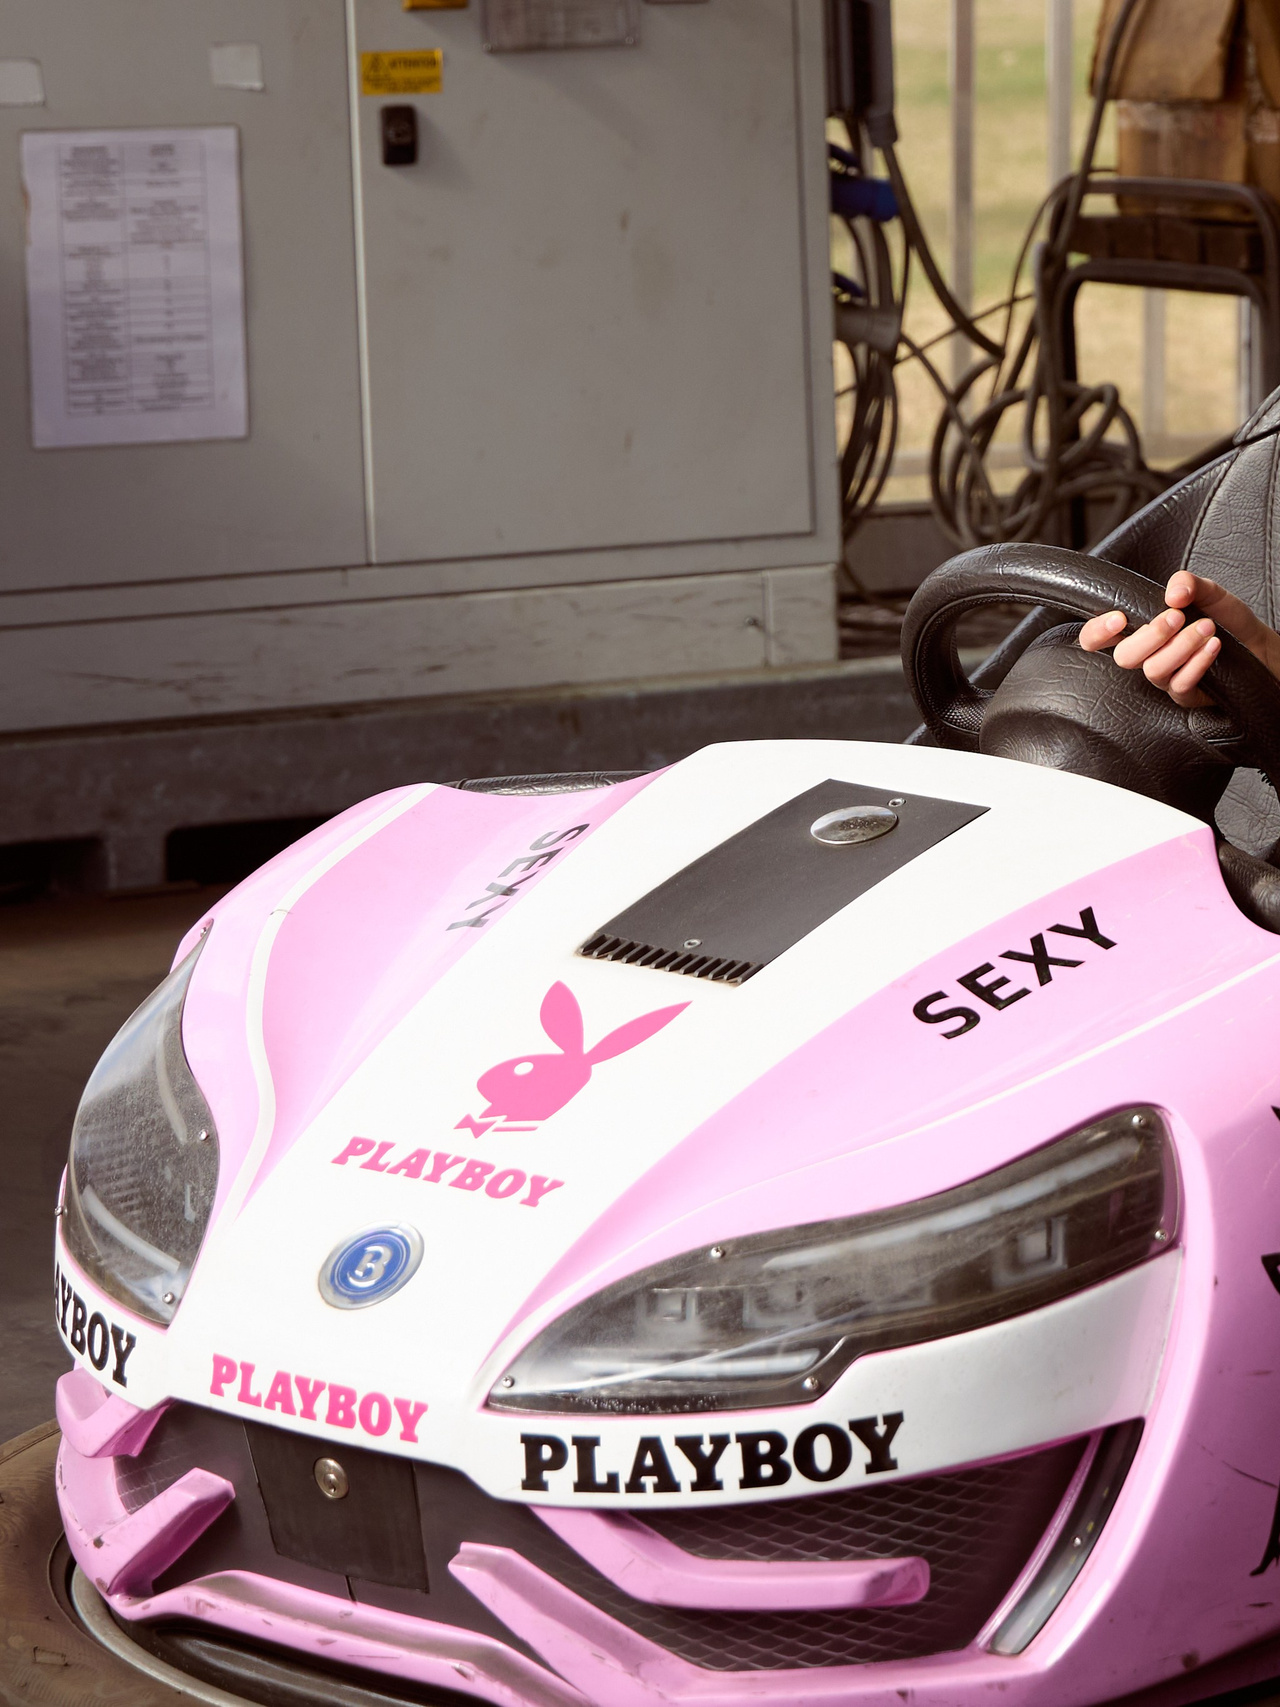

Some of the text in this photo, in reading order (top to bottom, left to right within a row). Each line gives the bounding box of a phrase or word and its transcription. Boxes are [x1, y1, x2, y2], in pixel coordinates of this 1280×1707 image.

[445, 823, 590, 931] SEXY
[912, 906, 1117, 1039] SEXY
[331, 1136, 564, 1207] PLAYBOY
[210, 1354, 428, 1443] PLAYBOY
[519, 1410, 904, 1493] PLAYBOY
